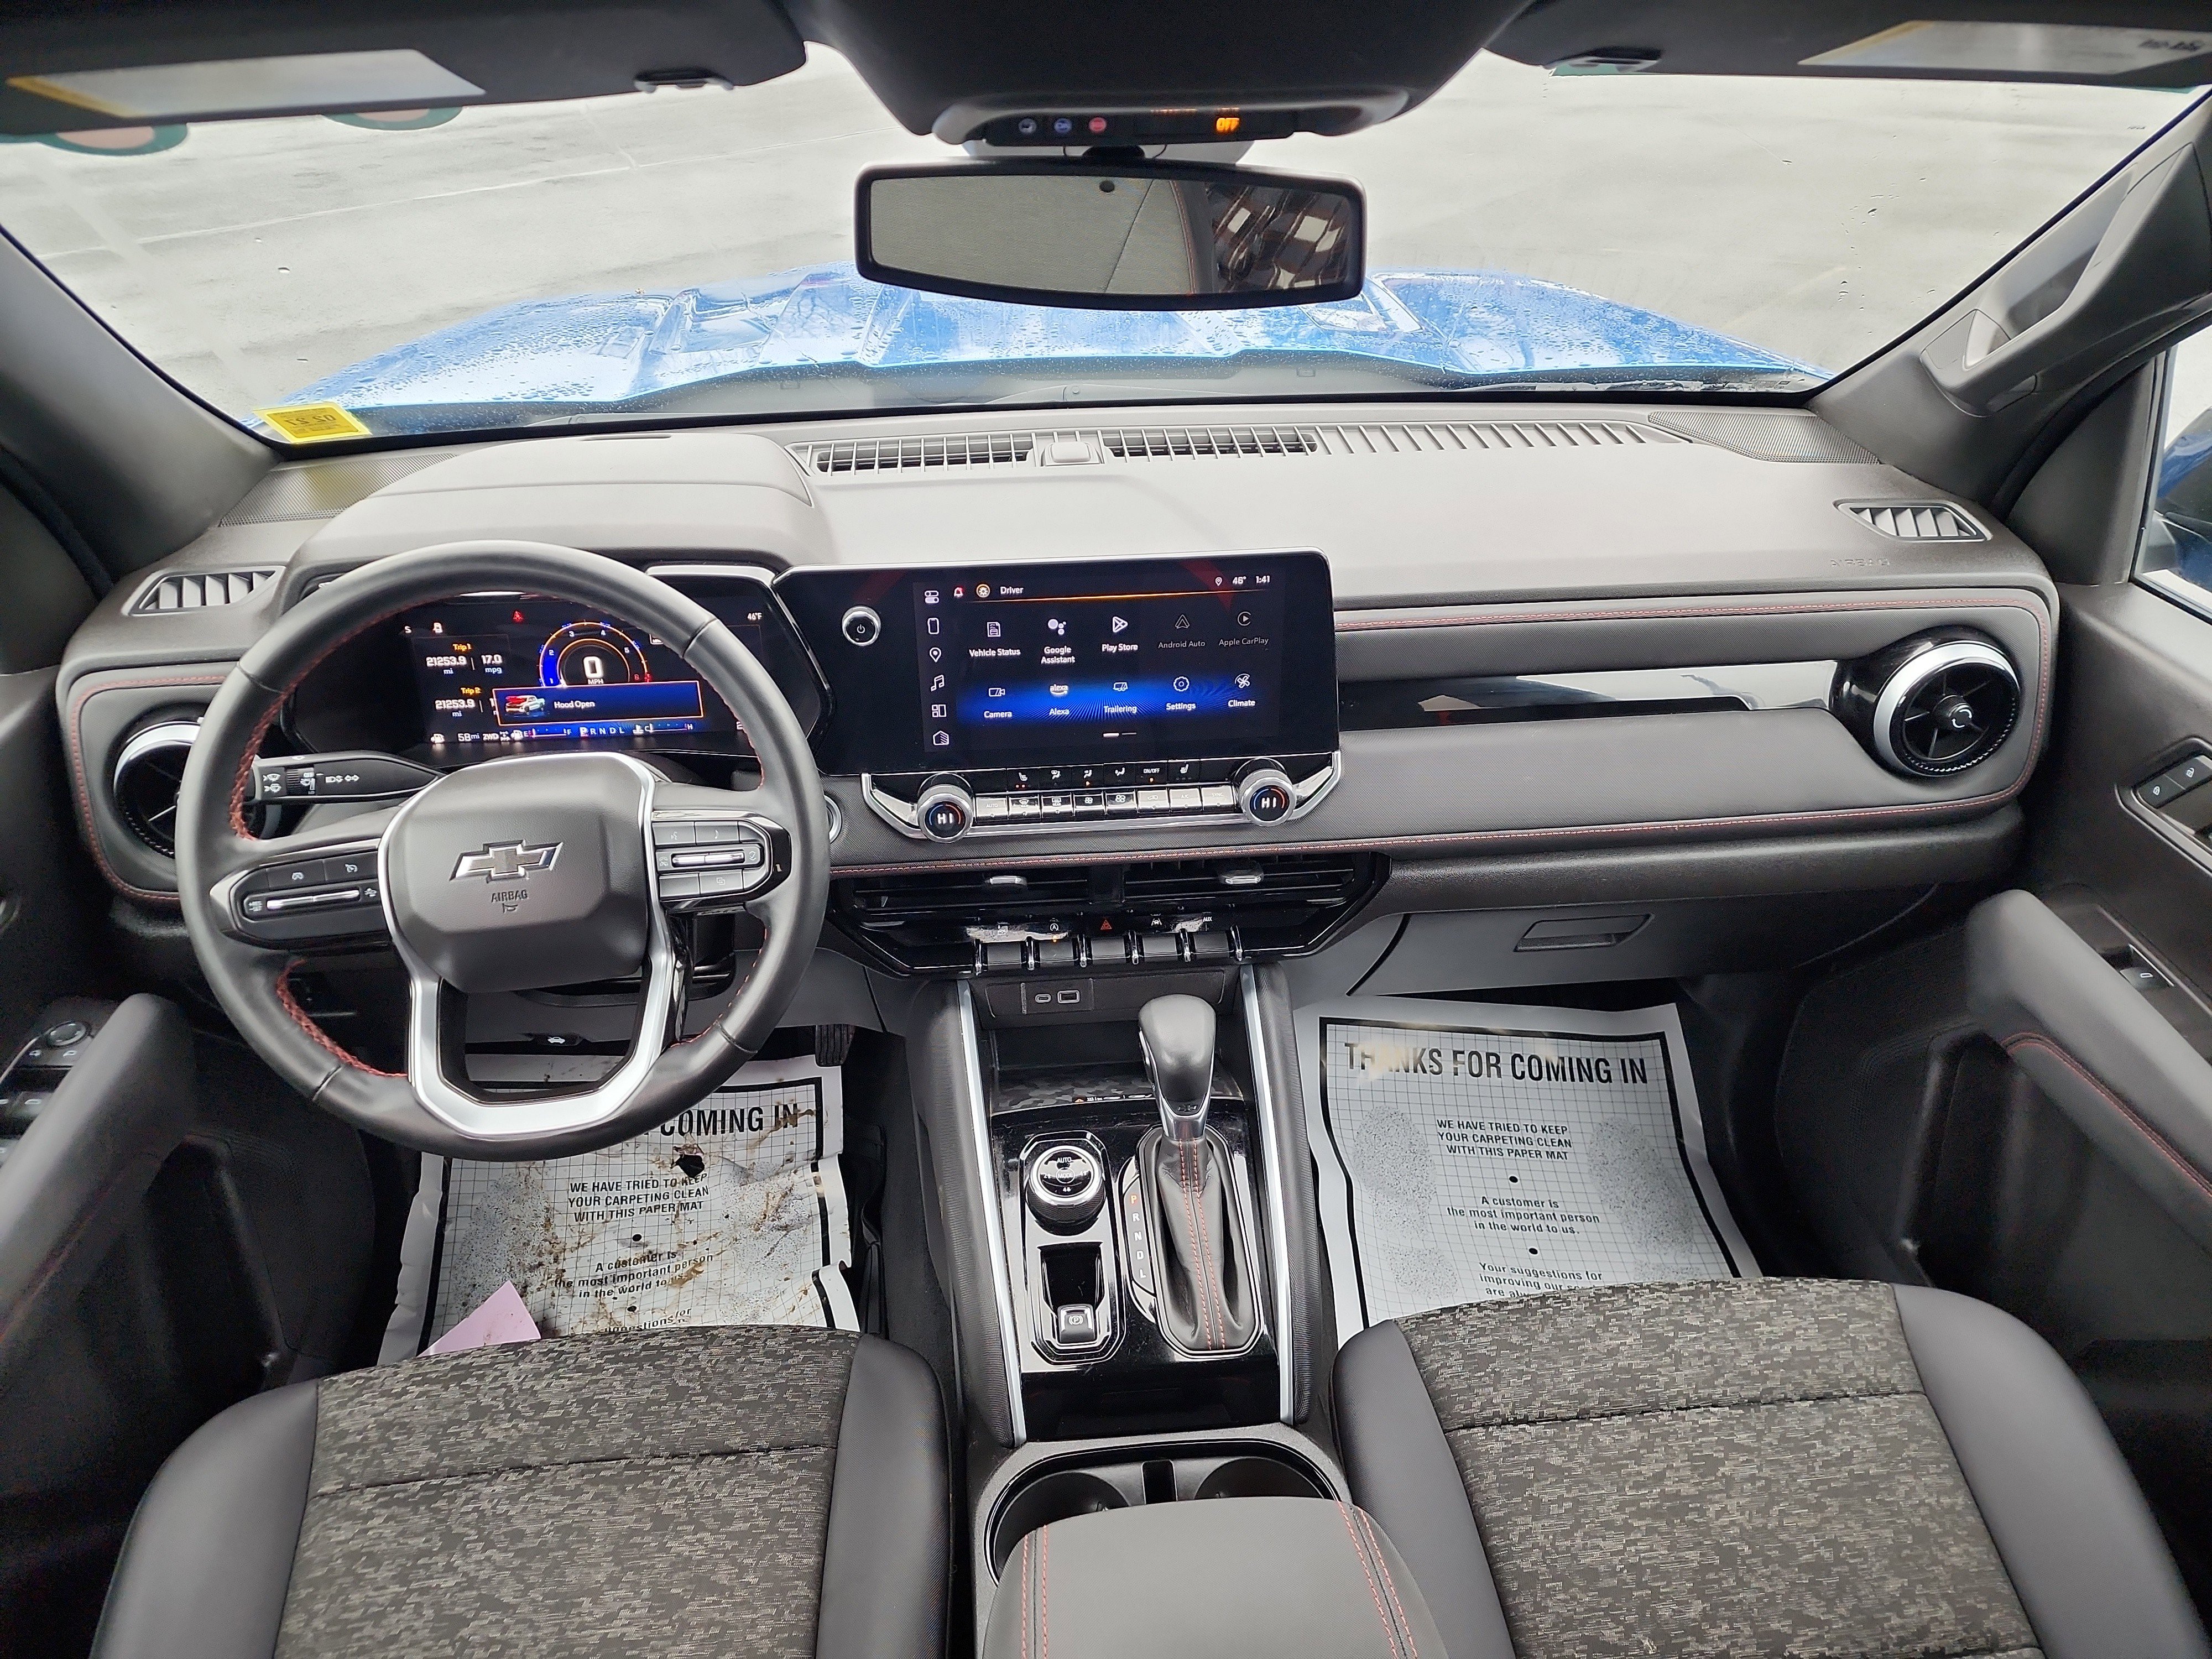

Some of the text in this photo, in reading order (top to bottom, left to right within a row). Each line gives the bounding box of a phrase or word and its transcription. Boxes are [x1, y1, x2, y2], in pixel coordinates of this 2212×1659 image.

[1256, 575, 1270, 583] 1:41
[1000, 586, 1024, 594] Driver
[453, 643, 467, 651] Trip
[1218, 637, 1269, 646] Apple CarPlay
[969, 648, 1021, 657] Vehicle Status
[1044, 646, 1072, 655] Google
[1102, 643, 1138, 653] Play Store
[426, 654, 503, 667] 21253.9 17.0
[1041, 655, 1076, 664] Assistant
[583, 656, 604, 679] 0
[435, 698, 476, 709] 21253.9
[575, 700, 596, 709] Open
[1104, 705, 1137, 713] Trailering
[1166, 702, 1196, 711] Settings
[984, 711, 1013, 719] Camera
[457, 733, 471, 742] 58
[1261, 796, 1277, 808] HI
[937, 812, 954, 825] HI
[491, 889, 528, 902] AIRBAG
[1344, 1043, 1648, 1084] THNKS FOR COMING IN
[774, 1103, 798, 1129] IN
[1437, 1119, 1568, 1135] WE HAVE TRIED TO KEEP
[1437, 1131, 1572, 1148] YOUR CARPETING CLEAN
[1446, 1145, 1568, 1160] WITH THIS PAPER MAT
[570, 1173, 708, 1193] WE HAVE TRIED TO KEEP
[568, 1185, 709, 1208] YOUR CARPETING CLEAN
[1131, 1195, 1137, 1204] P
[1481, 1196, 1559, 1208] A customer is
[573, 1201, 705, 1223] WITH THIS PAPER MAT
[1132, 1213, 1140, 1222] R
[1447, 1207, 1600, 1223] the most important person
[1474, 1220, 1580, 1234] in the world to us.
[1134, 1231, 1142, 1241] N
[1136, 1250, 1144, 1260] D
[595, 1251, 678, 1273] A customer is
[554, 1255, 713, 1288] the most important person
[1139, 1269, 1146, 1279] L
[1479, 1262, 1603, 1281] Your suggestions for
[579, 1289, 590, 1298] in
[594, 1288, 614, 1298] the
[618, 1281, 652, 1295] world
[656, 1279, 667, 1287] to
[1479, 1274, 1541, 1290] improving
[1544, 1282, 1563, 1291] our
[1485, 1287, 1505, 1297] are
